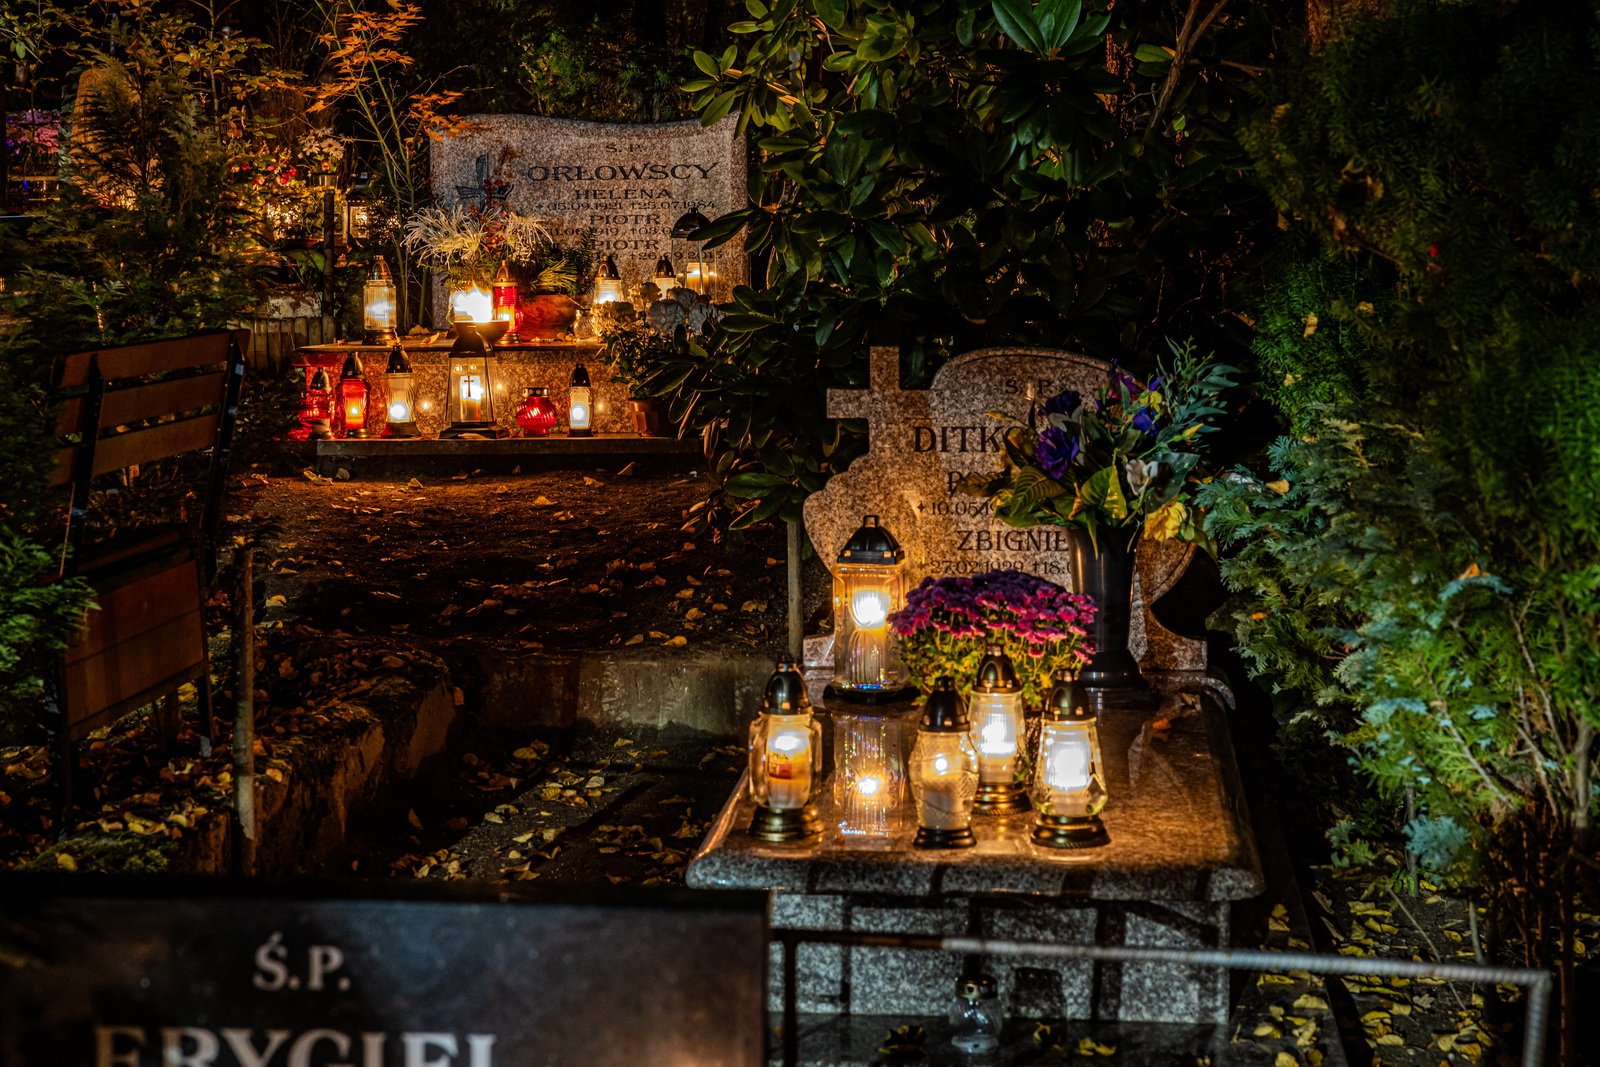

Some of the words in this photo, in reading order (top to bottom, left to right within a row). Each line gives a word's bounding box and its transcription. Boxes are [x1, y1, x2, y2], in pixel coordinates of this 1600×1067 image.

[527, 161, 719, 182] ORŁOWSCY
[575, 189, 673, 200] HELENA
[590, 215, 660, 225] PIOTR
[592, 240, 659, 250] PIOTR
[957, 530, 1070, 552] ZBIGNIE
